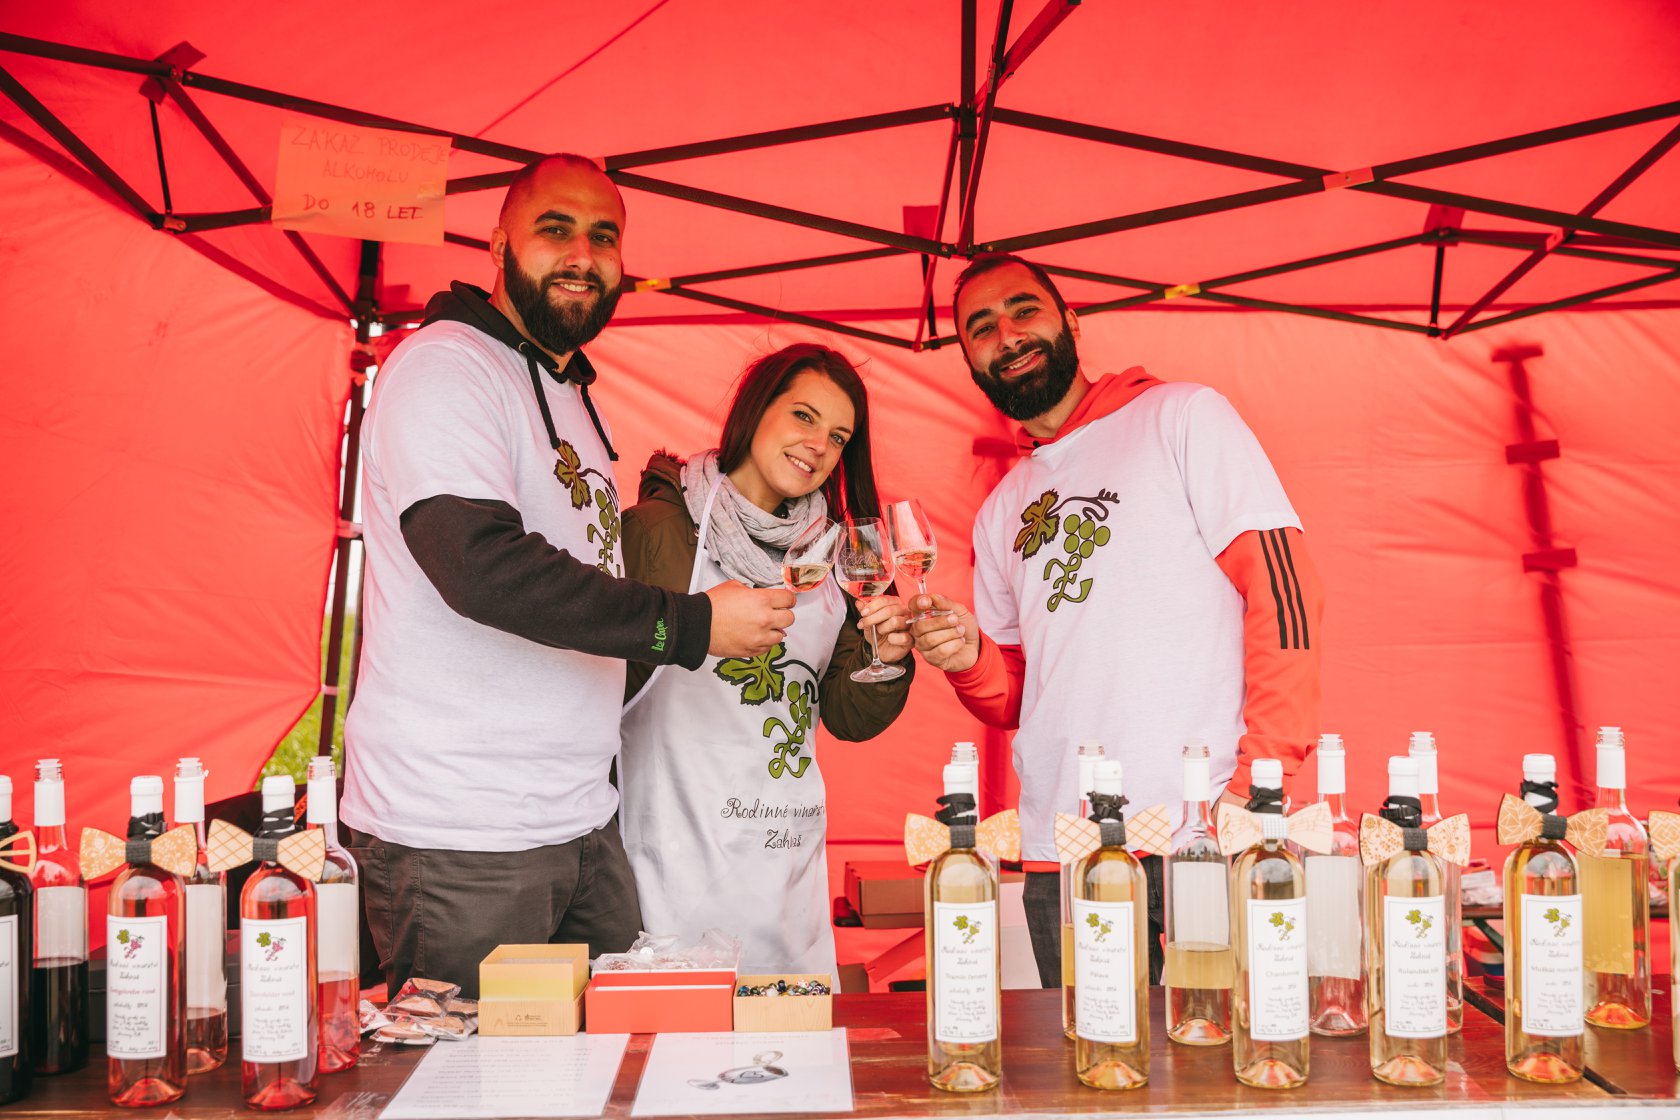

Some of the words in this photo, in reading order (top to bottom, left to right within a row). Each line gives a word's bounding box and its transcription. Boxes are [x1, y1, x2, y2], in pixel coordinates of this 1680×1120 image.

[291, 125, 364, 154] ZÁKAZ
[322, 160, 409, 183] ALKOHOLU
[303, 193, 329, 211] DO
[352, 201, 376, 219] 18
[387, 206, 424, 220] LET
[721, 798, 789, 819] Rodinné
